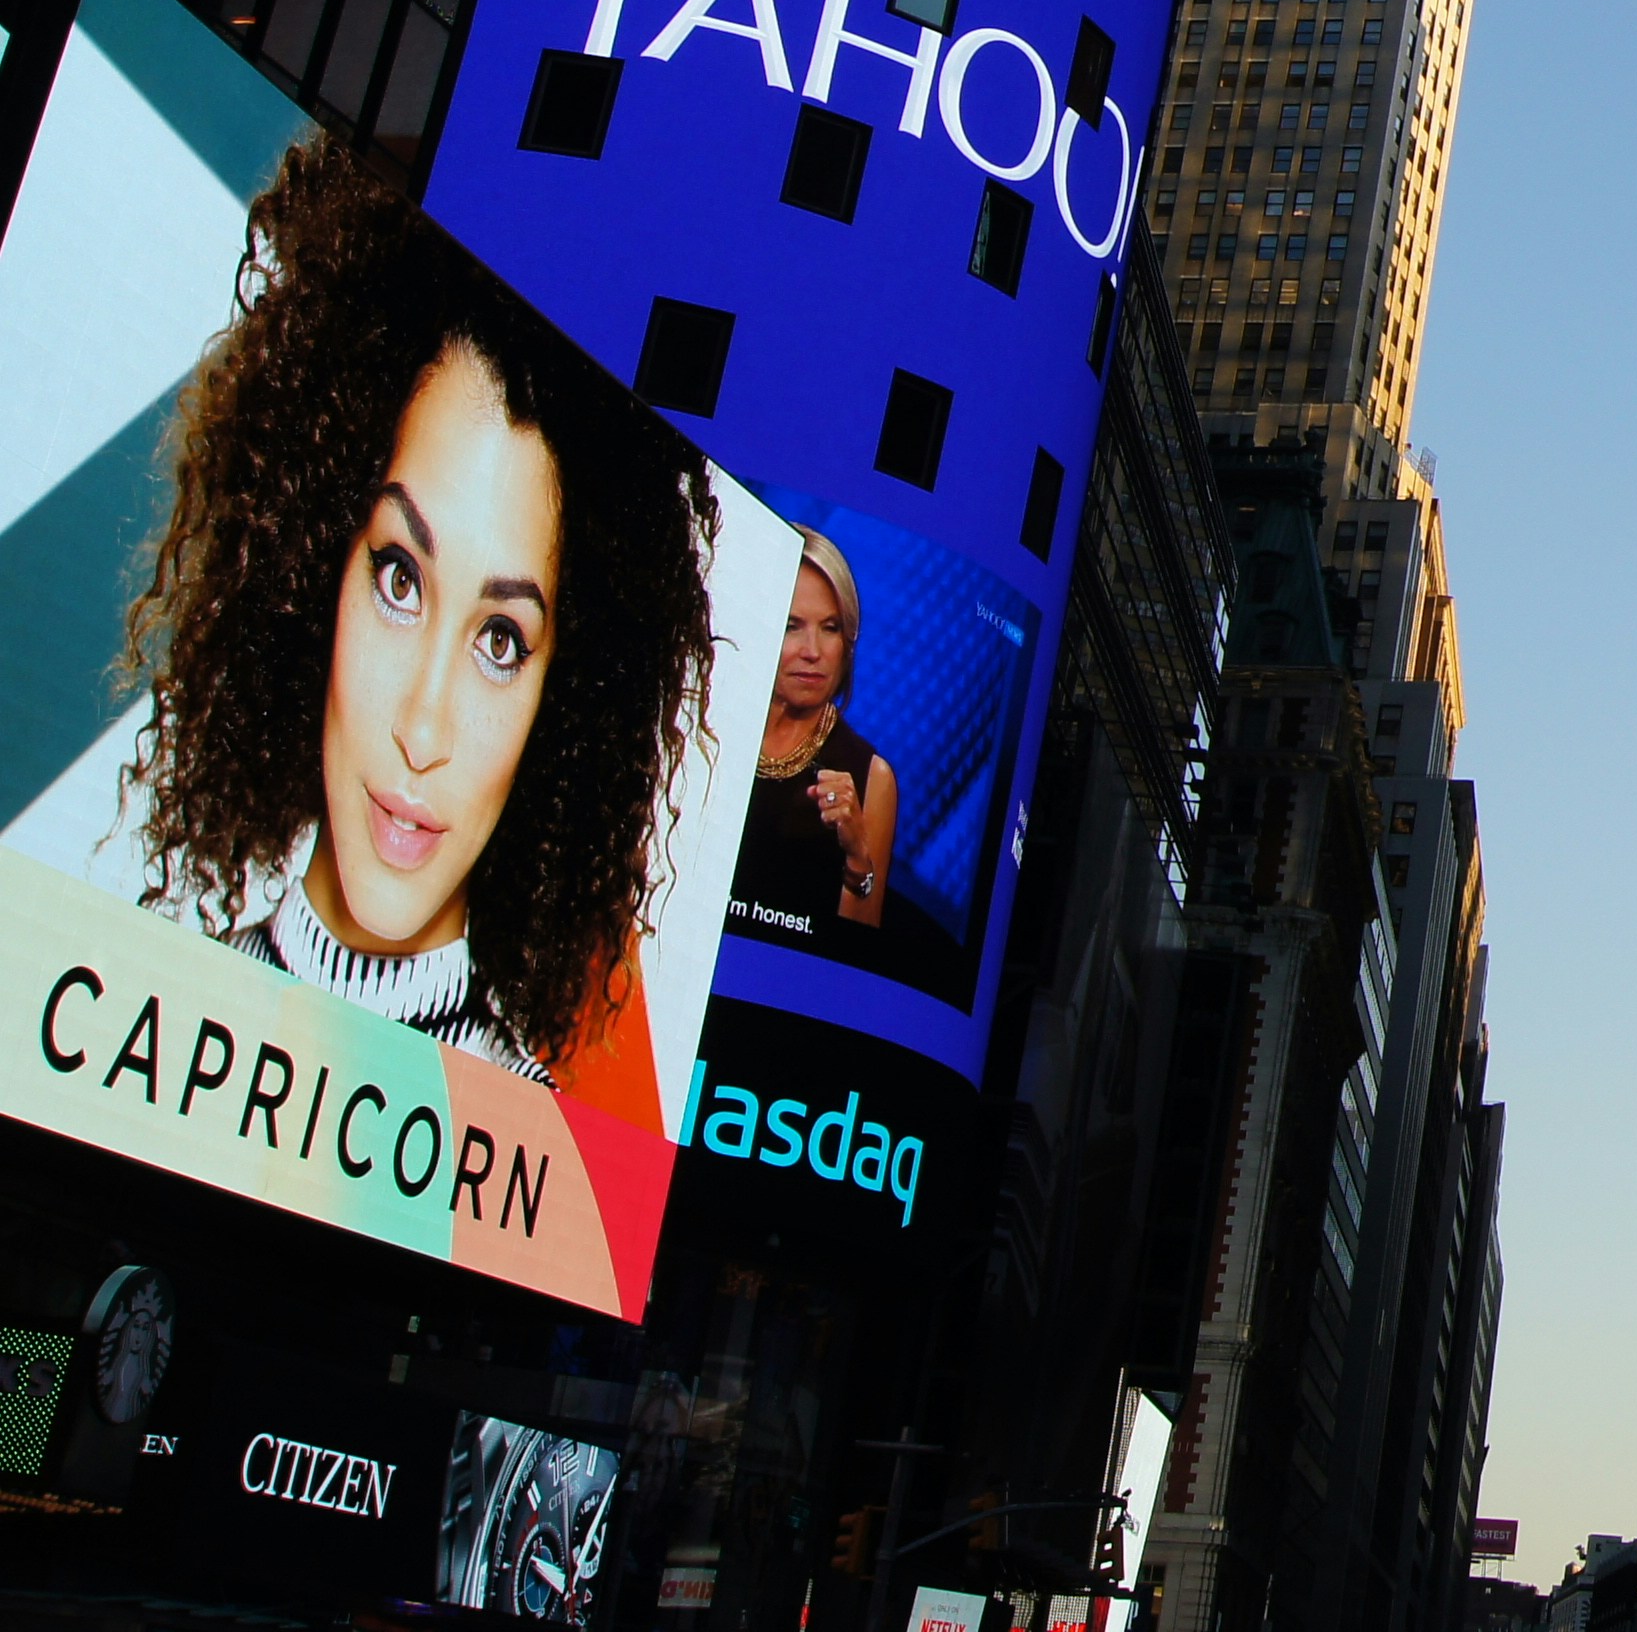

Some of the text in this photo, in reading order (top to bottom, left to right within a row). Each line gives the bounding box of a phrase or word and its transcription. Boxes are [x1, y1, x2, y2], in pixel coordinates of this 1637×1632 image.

[752, 900, 814, 935] honest.
[41, 965, 551, 1239] CAPRICORN
[239, 1430, 398, 1522] CITIZEN
